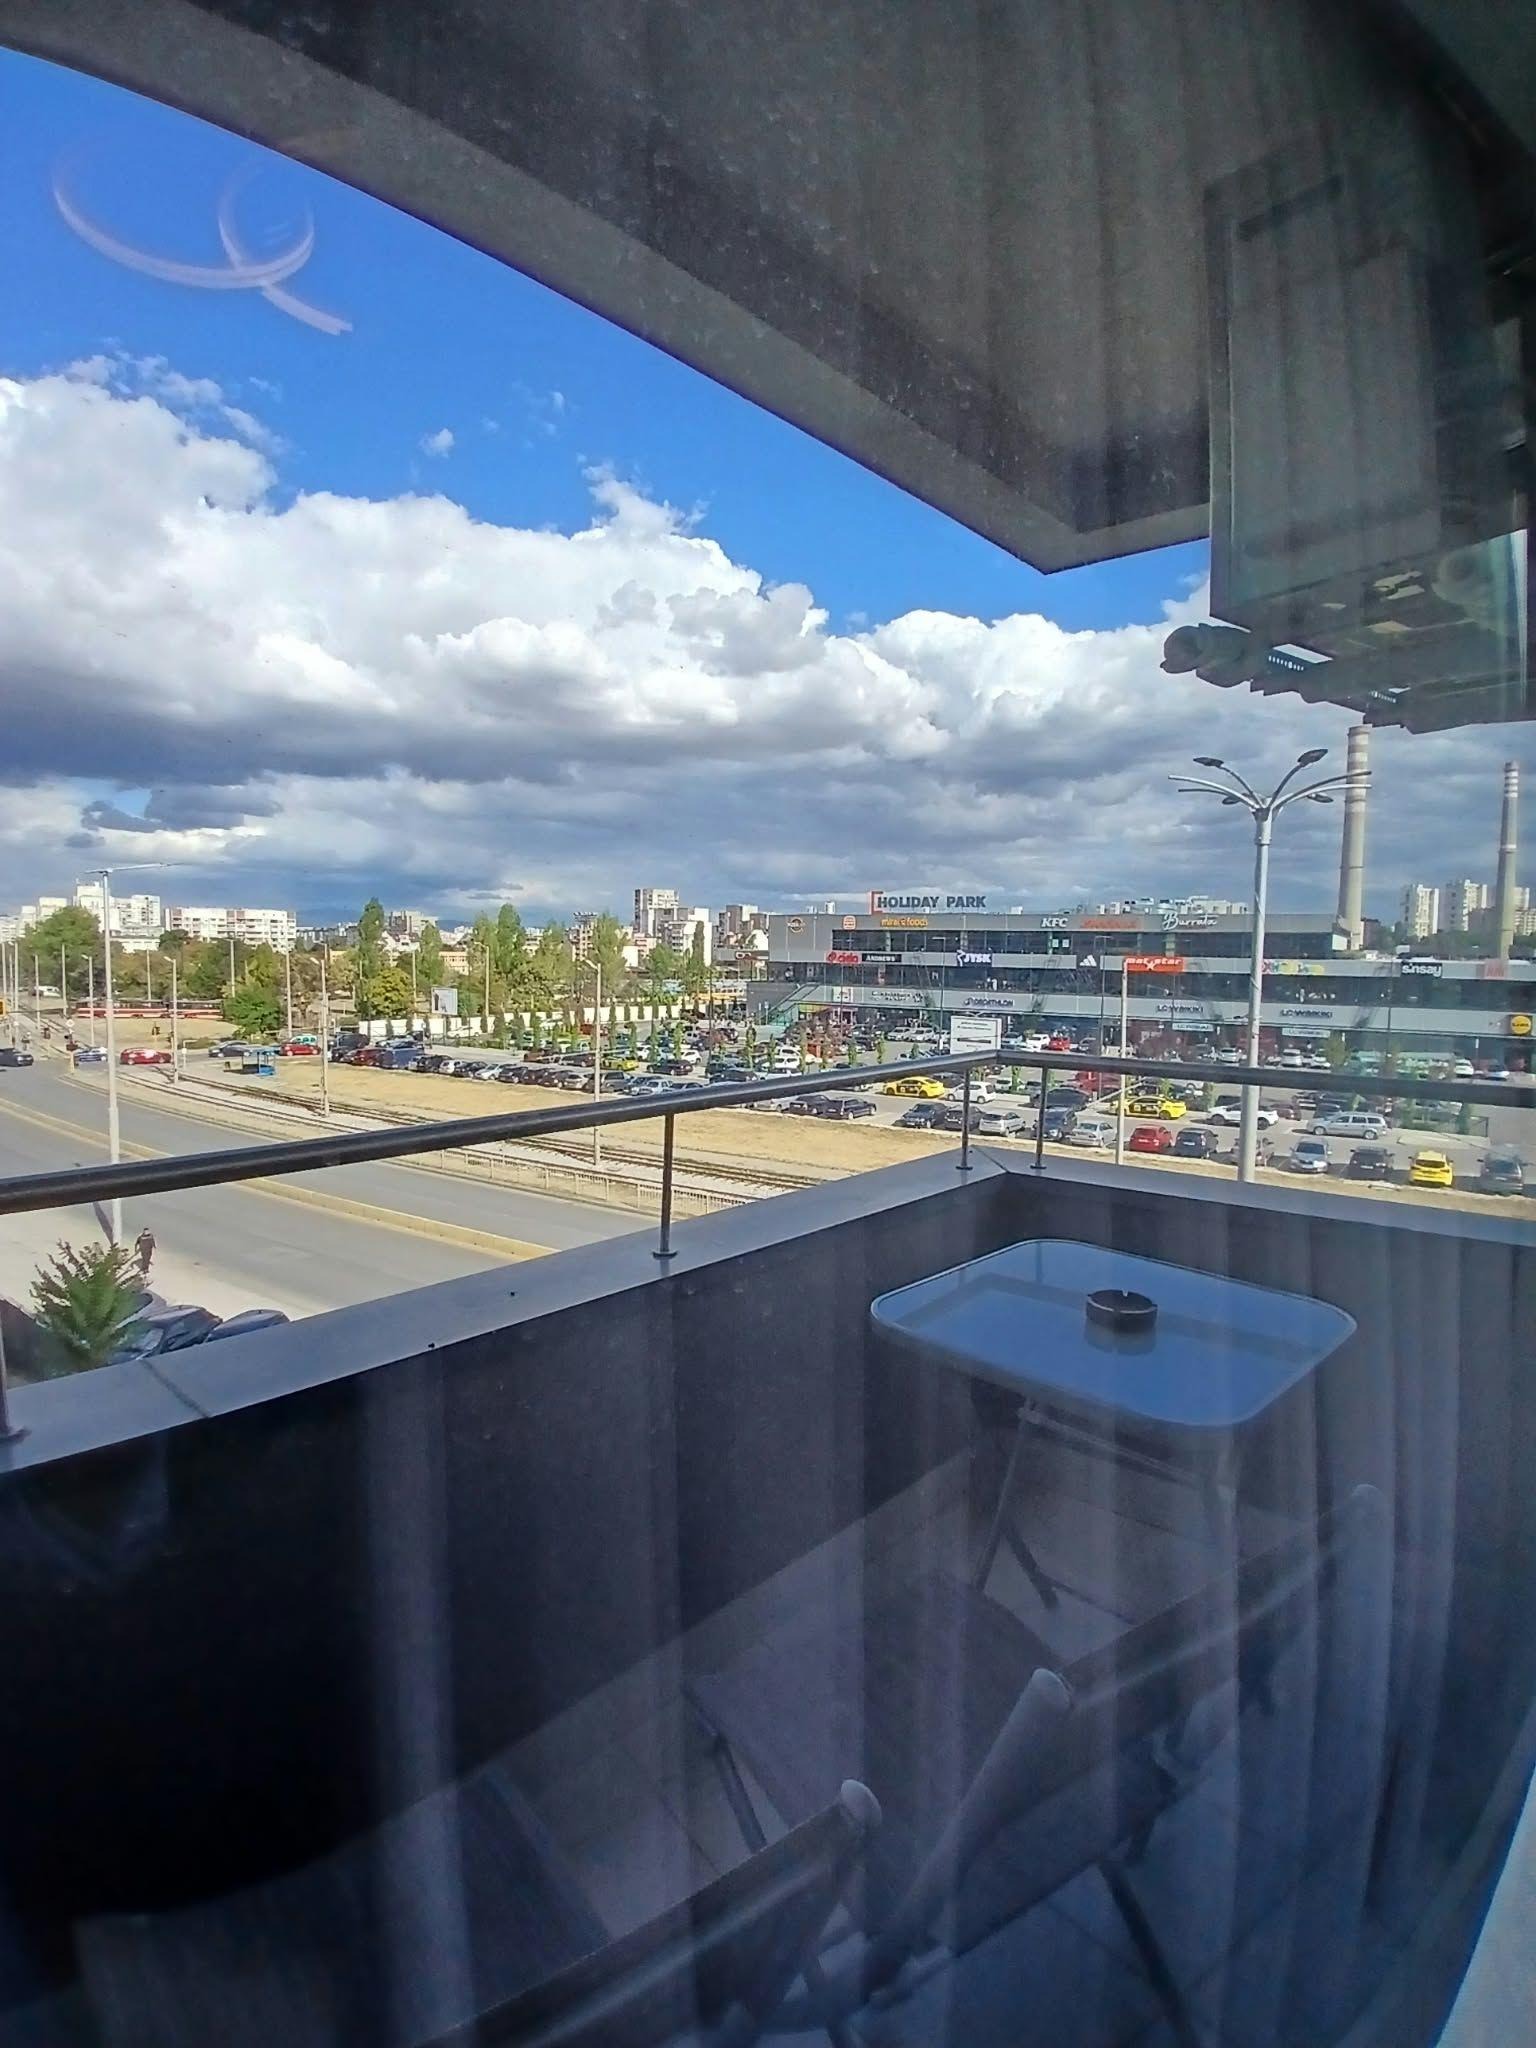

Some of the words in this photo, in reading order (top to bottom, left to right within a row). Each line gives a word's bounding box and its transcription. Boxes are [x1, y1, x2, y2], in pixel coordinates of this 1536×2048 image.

[877, 895, 940, 909] HOLIDAY
[946, 895, 987, 909] PARK
[1041, 917, 1069, 928] KFC
[1162, 911, 1219, 931] Burrata
[963, 953, 992, 963] JYSK
[1401, 963, 1442, 977] sinsay
